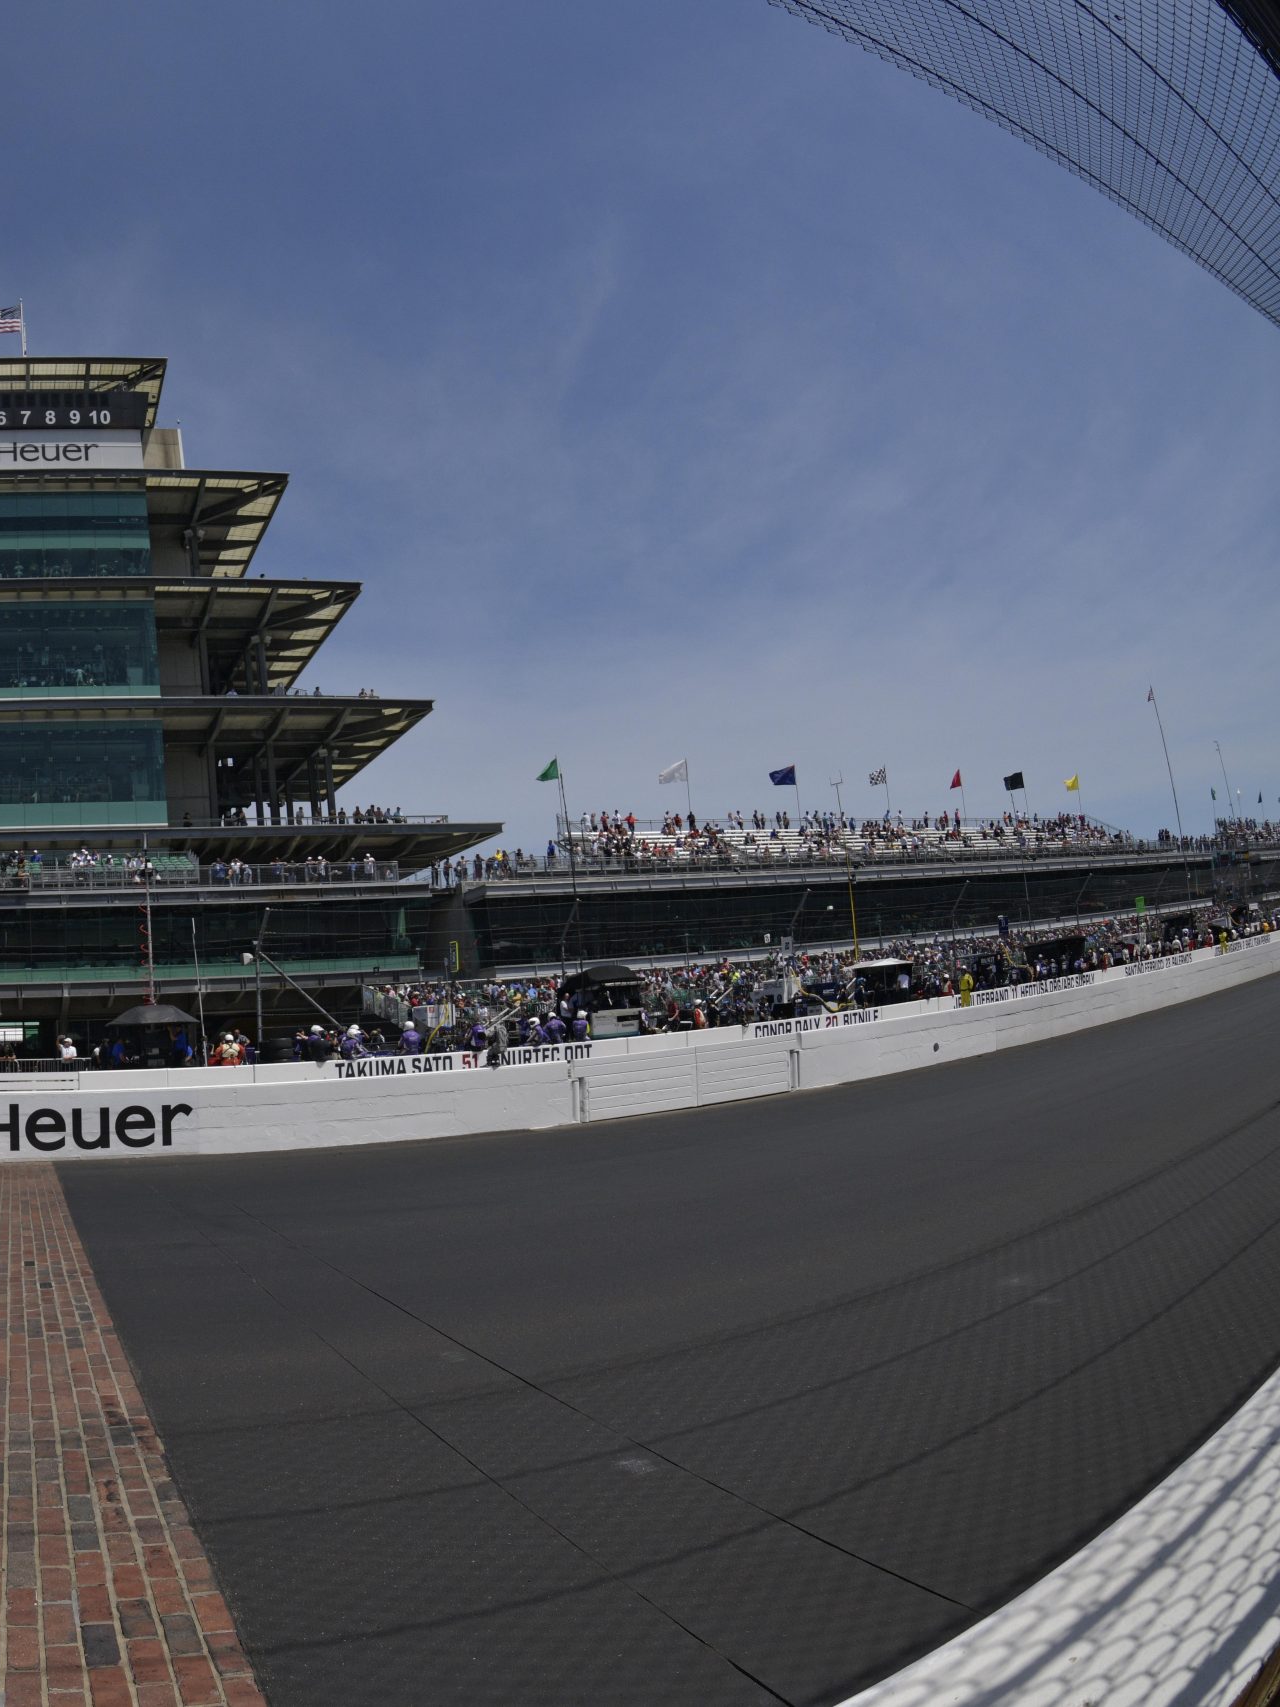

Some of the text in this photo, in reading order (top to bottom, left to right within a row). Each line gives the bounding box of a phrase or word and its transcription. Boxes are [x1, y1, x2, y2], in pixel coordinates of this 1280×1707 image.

[20, 410, 31, 425] 7
[45, 410, 56, 425] 8
[69, 410, 80, 424] 9
[88, 410, 111, 425] 10
[1011, 986, 1018, 1000] 11
[755, 1021, 792, 1038] CONOR
[335, 1060, 407, 1079] TAKUMA
[412, 1056, 453, 1074] SATO
[462, 1053, 478, 1069] 51
